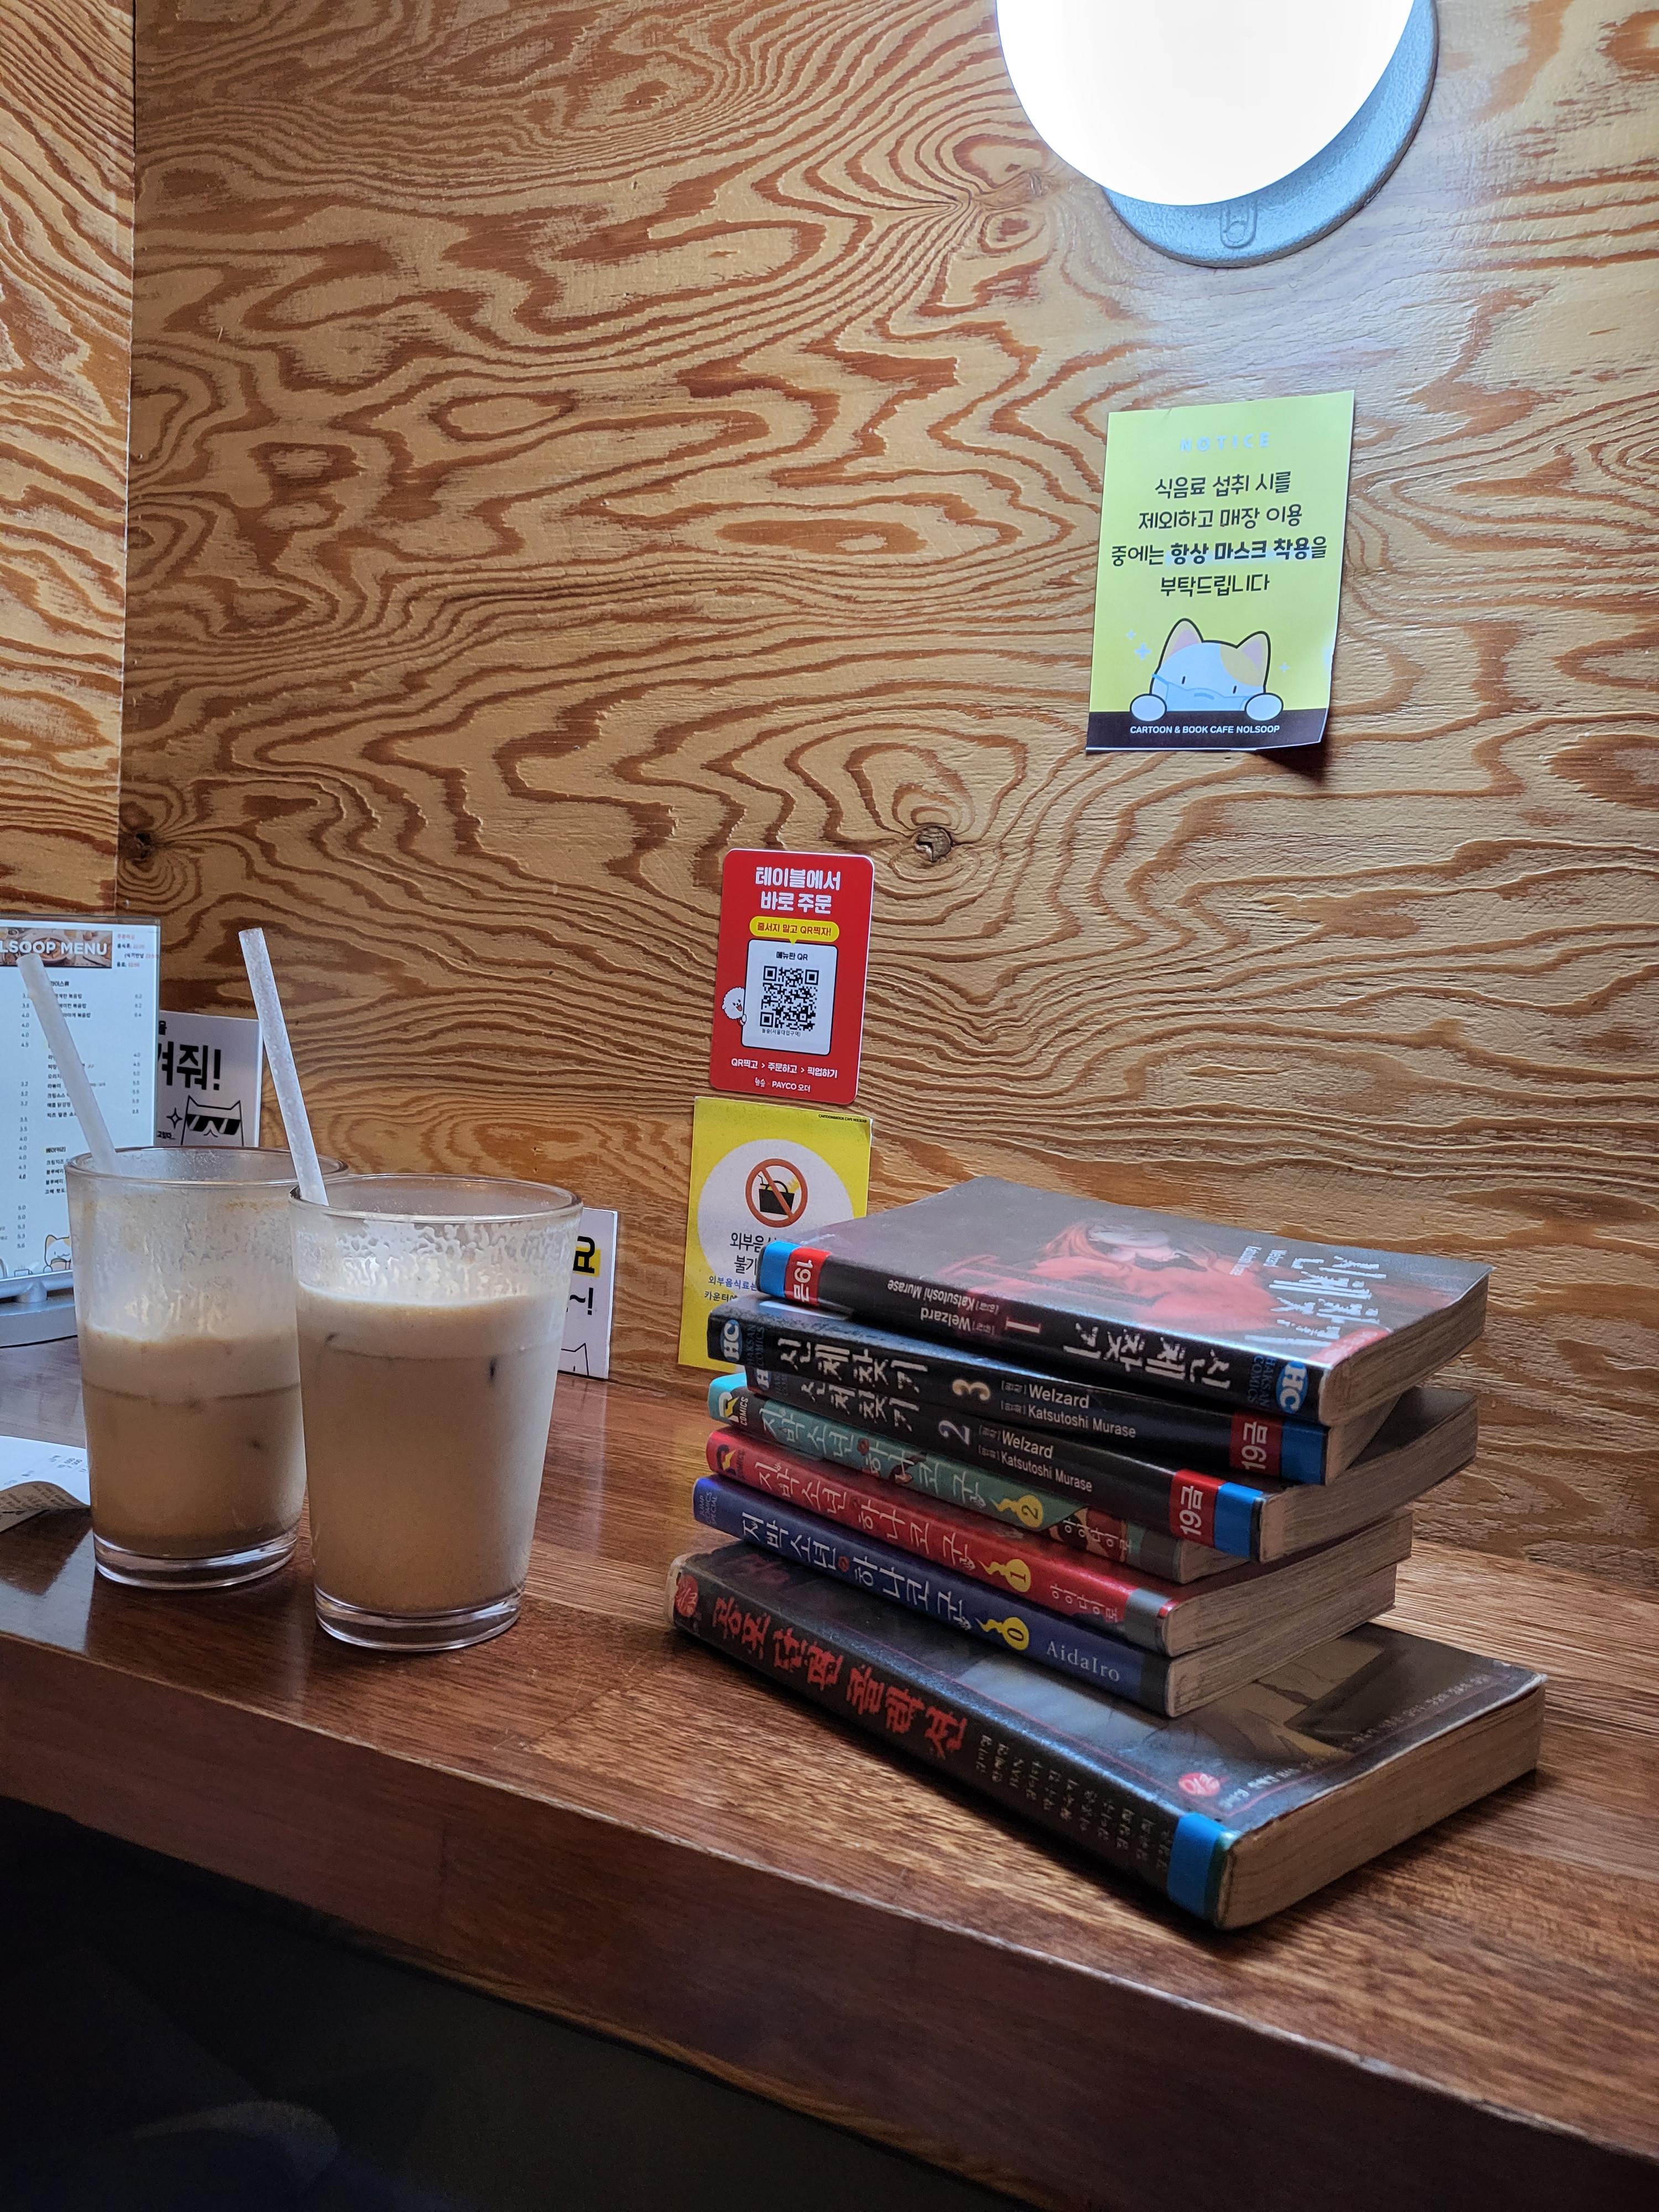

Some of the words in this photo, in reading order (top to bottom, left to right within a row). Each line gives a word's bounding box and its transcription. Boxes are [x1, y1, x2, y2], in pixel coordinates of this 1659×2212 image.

[1180, 432, 1271, 452] NOTICE
[1155, 477, 1207, 499] 식음료
[1212, 474, 1249, 497] 섭취
[1255, 471, 1291, 494] 시를
[1139, 510, 1213, 530] 제외하고
[1220, 507, 1260, 529] 매장
[1266, 504, 1303, 527] 이용
[1111, 545, 1164, 567] 중에는
[1170, 542, 1209, 565] 항상
[1214, 541, 1267, 562] 마스크
[1273, 536, 1327, 561] 착용을
[1160, 573, 1270, 597] 부탁드립니다
[1130, 726, 1173, 734] CARTOON
[1174, 726, 1181, 734] &
[1182, 726, 1208, 734] BOOK
[1210, 726, 1234, 734] CAFE
[1236, 725, 1280, 734] NOLSOOP
[755, 867, 841, 891] 테이블에서
[760, 891, 794, 911] 바로
[797, 893, 832, 914] 주문
[757, 922, 780, 932] 줄서지
[782, 924, 798, 933] 말고
[800, 926, 832, 936] QR찍자!
[0, 940, 56, 954] LSOOP
[60, 941, 108, 956] MENU
[776, 951, 796, 960] 메뉴판
[731, 1058, 759, 1070] QR찍고
[767, 1062, 797, 1073] 주문하고
[807, 1067, 838, 1079] 픽업하기
[771, 1081, 797, 1091] PAYCO
[797, 1084, 811, 1093] 오더
[730, 1232, 776, 1253] 외부음
[792, 1259, 814, 1303] 19금
[887, 1279, 922, 1299] Murase
[923, 1287, 976, 1311] Katsutoshi
[1245, 1255, 1386, 1347] 신체찾기
[919, 1307, 972, 1333] Welzard
[1006, 1316, 1041, 1334] 1
[723, 1323, 739, 1361] HC
[755, 1327, 765, 1367] COMICS
[778, 1337, 928, 1394] 신체찾기
[1062, 1323, 1230, 1390] 신체찾기
[756, 1368, 770, 1389] H
[951, 1379, 991, 1401] 3
[1280, 1361, 1308, 1413] HC
[1028, 1383, 1090, 1409] Welzard
[739, 1396, 749, 1426] COMICS
[1027, 1405, 1089, 1430] Katsutoshi
[1092, 1419, 1136, 1438] Murase
[759, 1407, 854, 1458] 지박소년
[938, 1420, 971, 1446] 2
[1001, 1430, 1053, 1459] Welzard
[1241, 1421, 1268, 1470] 19금
[1000, 1452, 1052, 1478] Katsutoshi
[1055, 1467, 1093, 1493] Murase
[755, 1462, 847, 1514] 지박소년
[1021, 1504, 1039, 1520] 2
[1179, 1485, 1204, 1536] 19금
[742, 1512, 837, 1571] 지박소년
[1009, 1571, 1027, 1583] 1
[1007, 1627, 1025, 1642] 0
[1046, 1640, 1120, 1682] AidaIro
